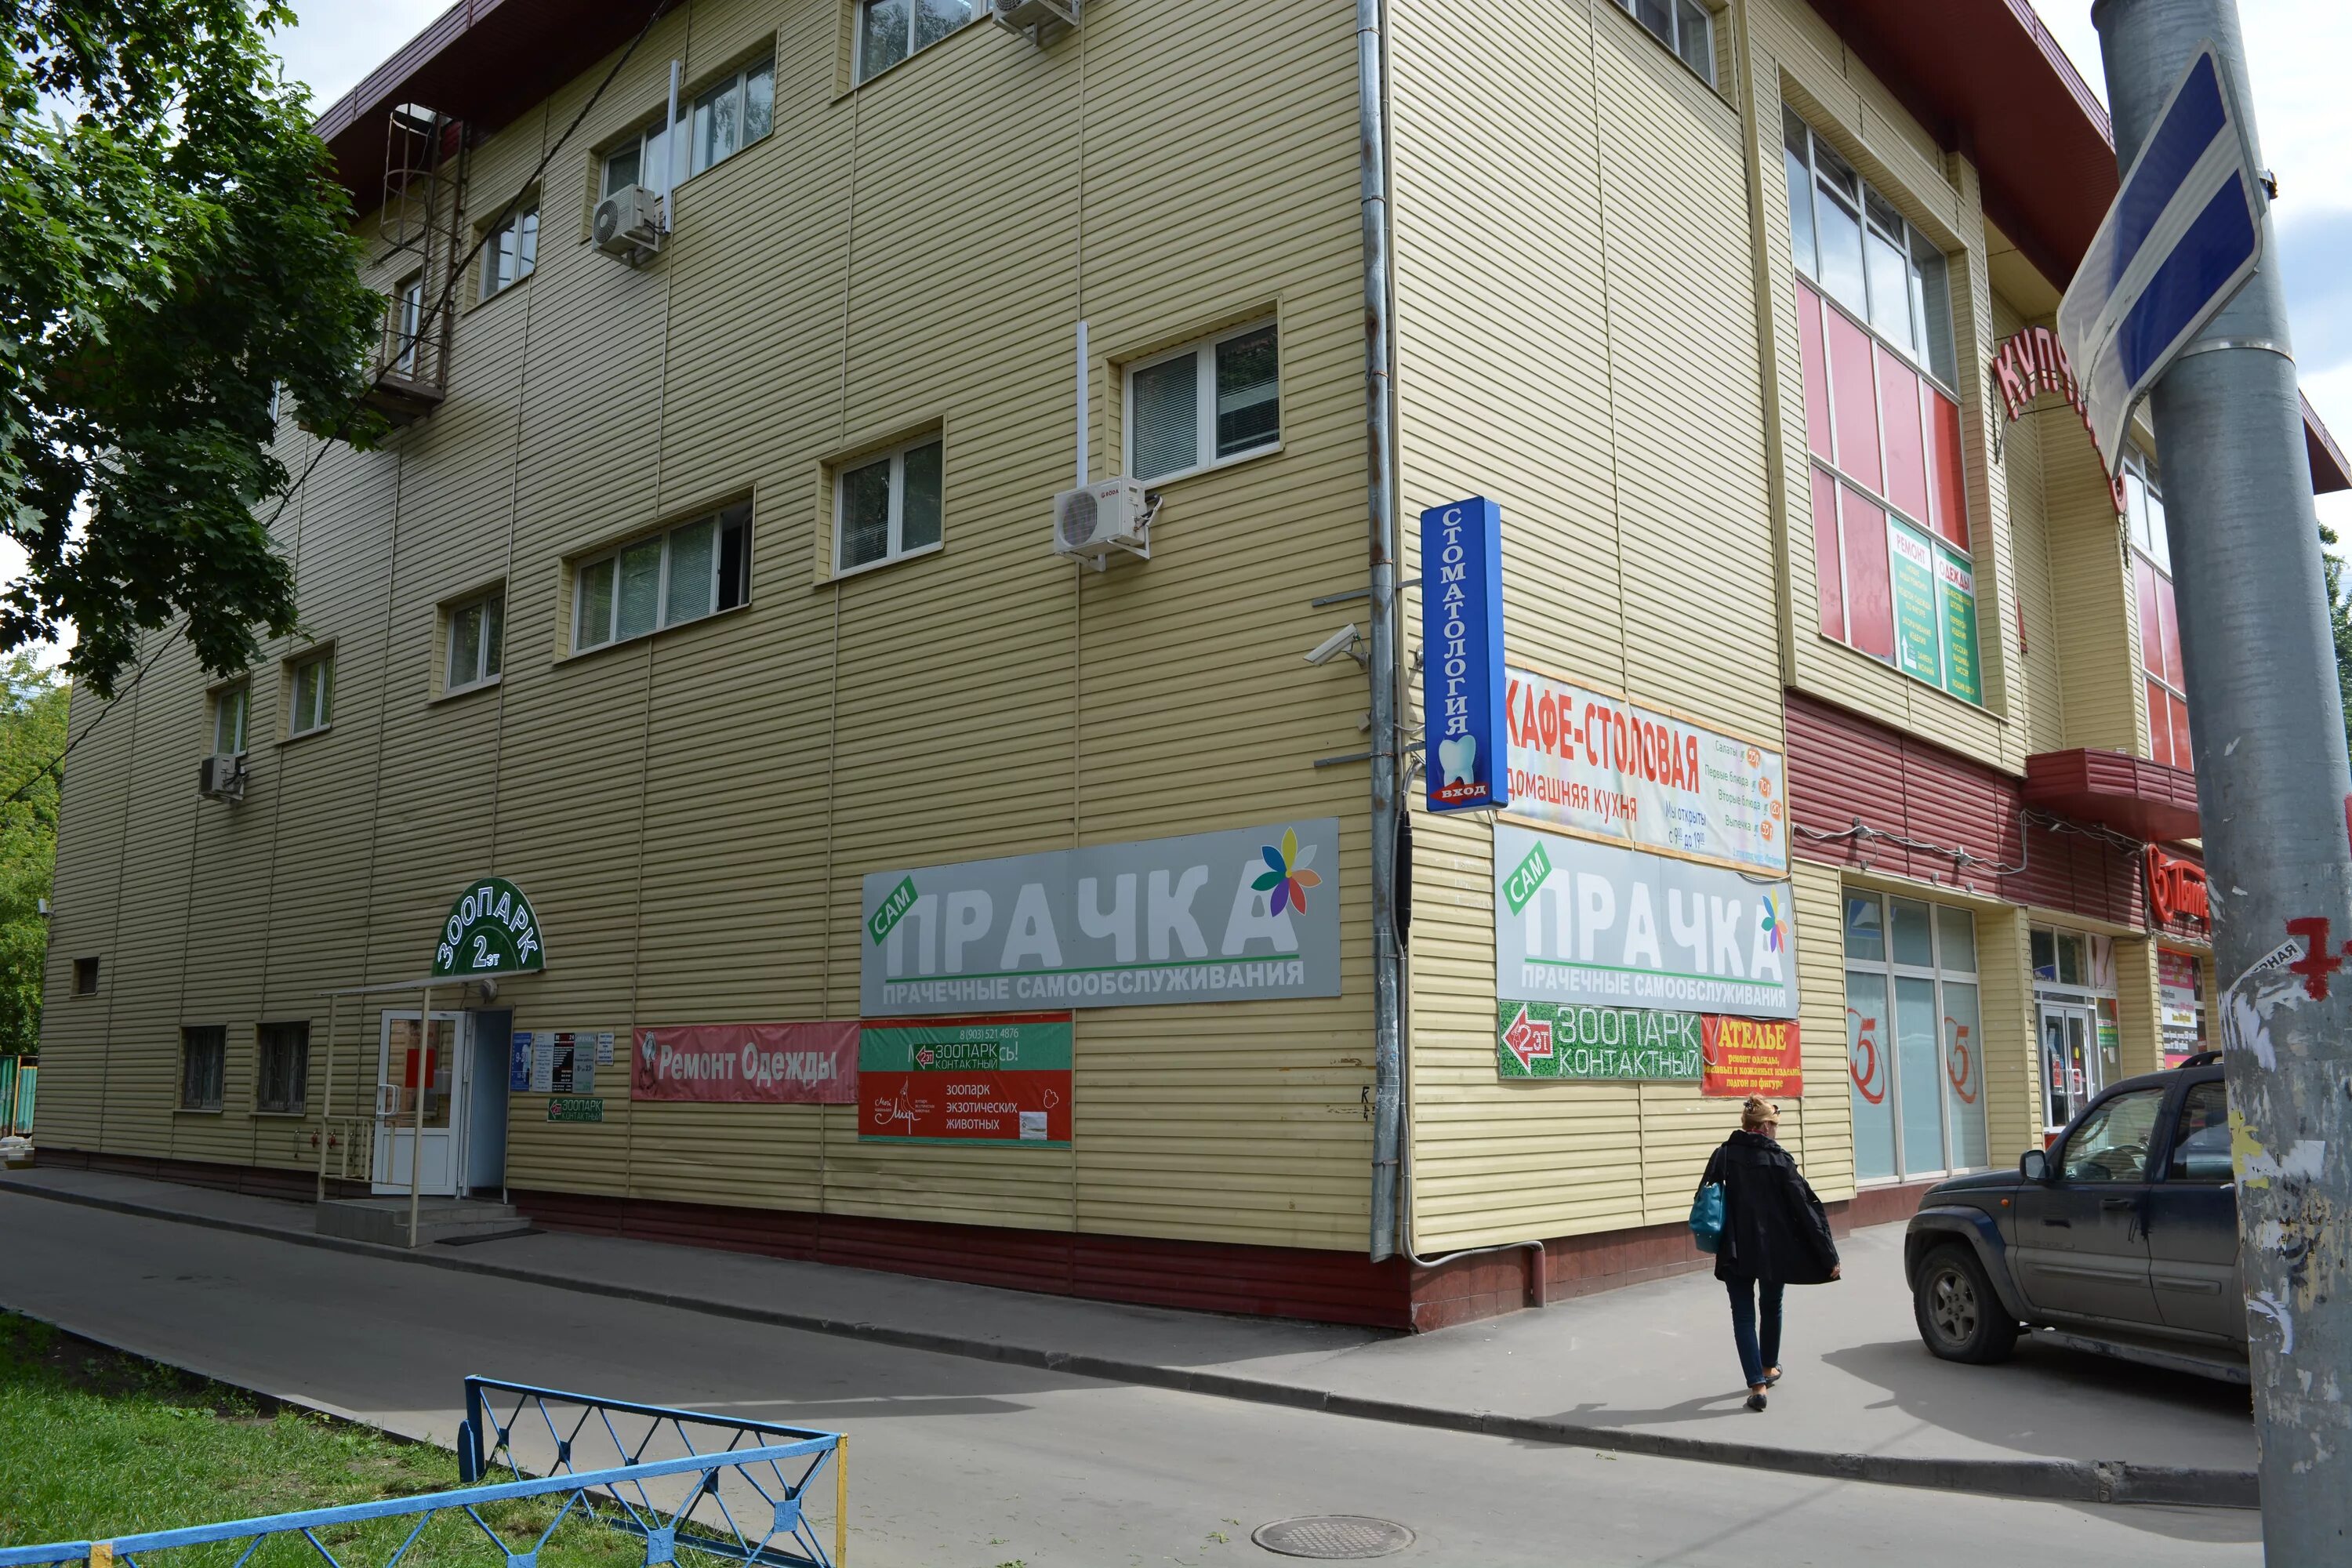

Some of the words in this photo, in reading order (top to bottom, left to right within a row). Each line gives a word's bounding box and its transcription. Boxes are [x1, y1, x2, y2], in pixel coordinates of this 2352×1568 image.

[1896, 534, 1926, 564] РЕМОНТ
[1940, 561, 1970, 591] ОДЕЖДЫ
[1440, 507, 1468, 736] СТОМАТОЛОГИЯ
[1506, 679, 1700, 794] КАФЕ-СТОЛОВАЯ
[1715, 740, 1737, 757] Салаты
[1704, 764, 1728, 782] Первые
[1730, 771, 1748, 787] блюда
[1508, 768, 1589, 811] домашняя
[1595, 788, 1637, 824] кухня
[1718, 789, 1740, 806] Вторые
[1742, 794, 1760, 811] блюда
[1665, 800, 1676, 818] Мы
[1678, 806, 1706, 827] открыты
[1725, 815, 1751, 832] Выпечка
[1685, 836, 1692, 849] до
[1510, 851, 1546, 903] САМ
[874, 884, 911, 936] САМ
[886, 858, 1299, 978] ПРАЧКА
[437, 886, 539, 970] ЗООПАРК
[1525, 866, 1786, 982] ПРАЧКА
[882, 977, 1010, 1005] ПРАЧЕЧНЫЕ
[1016, 960, 1305, 998] САМООБСЛУЖИВАНИЯ
[1522, 964, 1630, 996] ПРАЧЕЧНЫЕ
[1635, 975, 1786, 1008] САМООБСЛУЖИВАНИЯ
[960, 1030, 965, 1040] 8
[966, 1029, 984, 1041] (903)
[985, 1029, 998, 1040] 521
[1000, 1028, 1019, 1039] 4876
[1557, 1006, 1698, 1048] ЗООПАРК
[1718, 1020, 1787, 1051] АТЕЛЬЕ
[935, 1043, 997, 1058] ЗООПАРК
[935, 1058, 998, 1069] КОНТАКТНЫЙ
[1559, 1048, 1699, 1076] КОНТАКТНЫЙ
[1728, 1054, 1751, 1065] ремонт
[659, 1044, 736, 1080] Ремонт
[741, 1042, 837, 1088] Одежды
[946, 1084, 990, 1098] зоопарк
[1726, 1079, 1749, 1088] подгон
[1759, 1077, 1784, 1091] фигуре
[561, 1112, 602, 1121] КОНТАКТНЫЙ
[562, 1099, 601, 1112] ЗООПАРК
[946, 1102, 1018, 1113] экзотических
[946, 1119, 1000, 1131] животных
